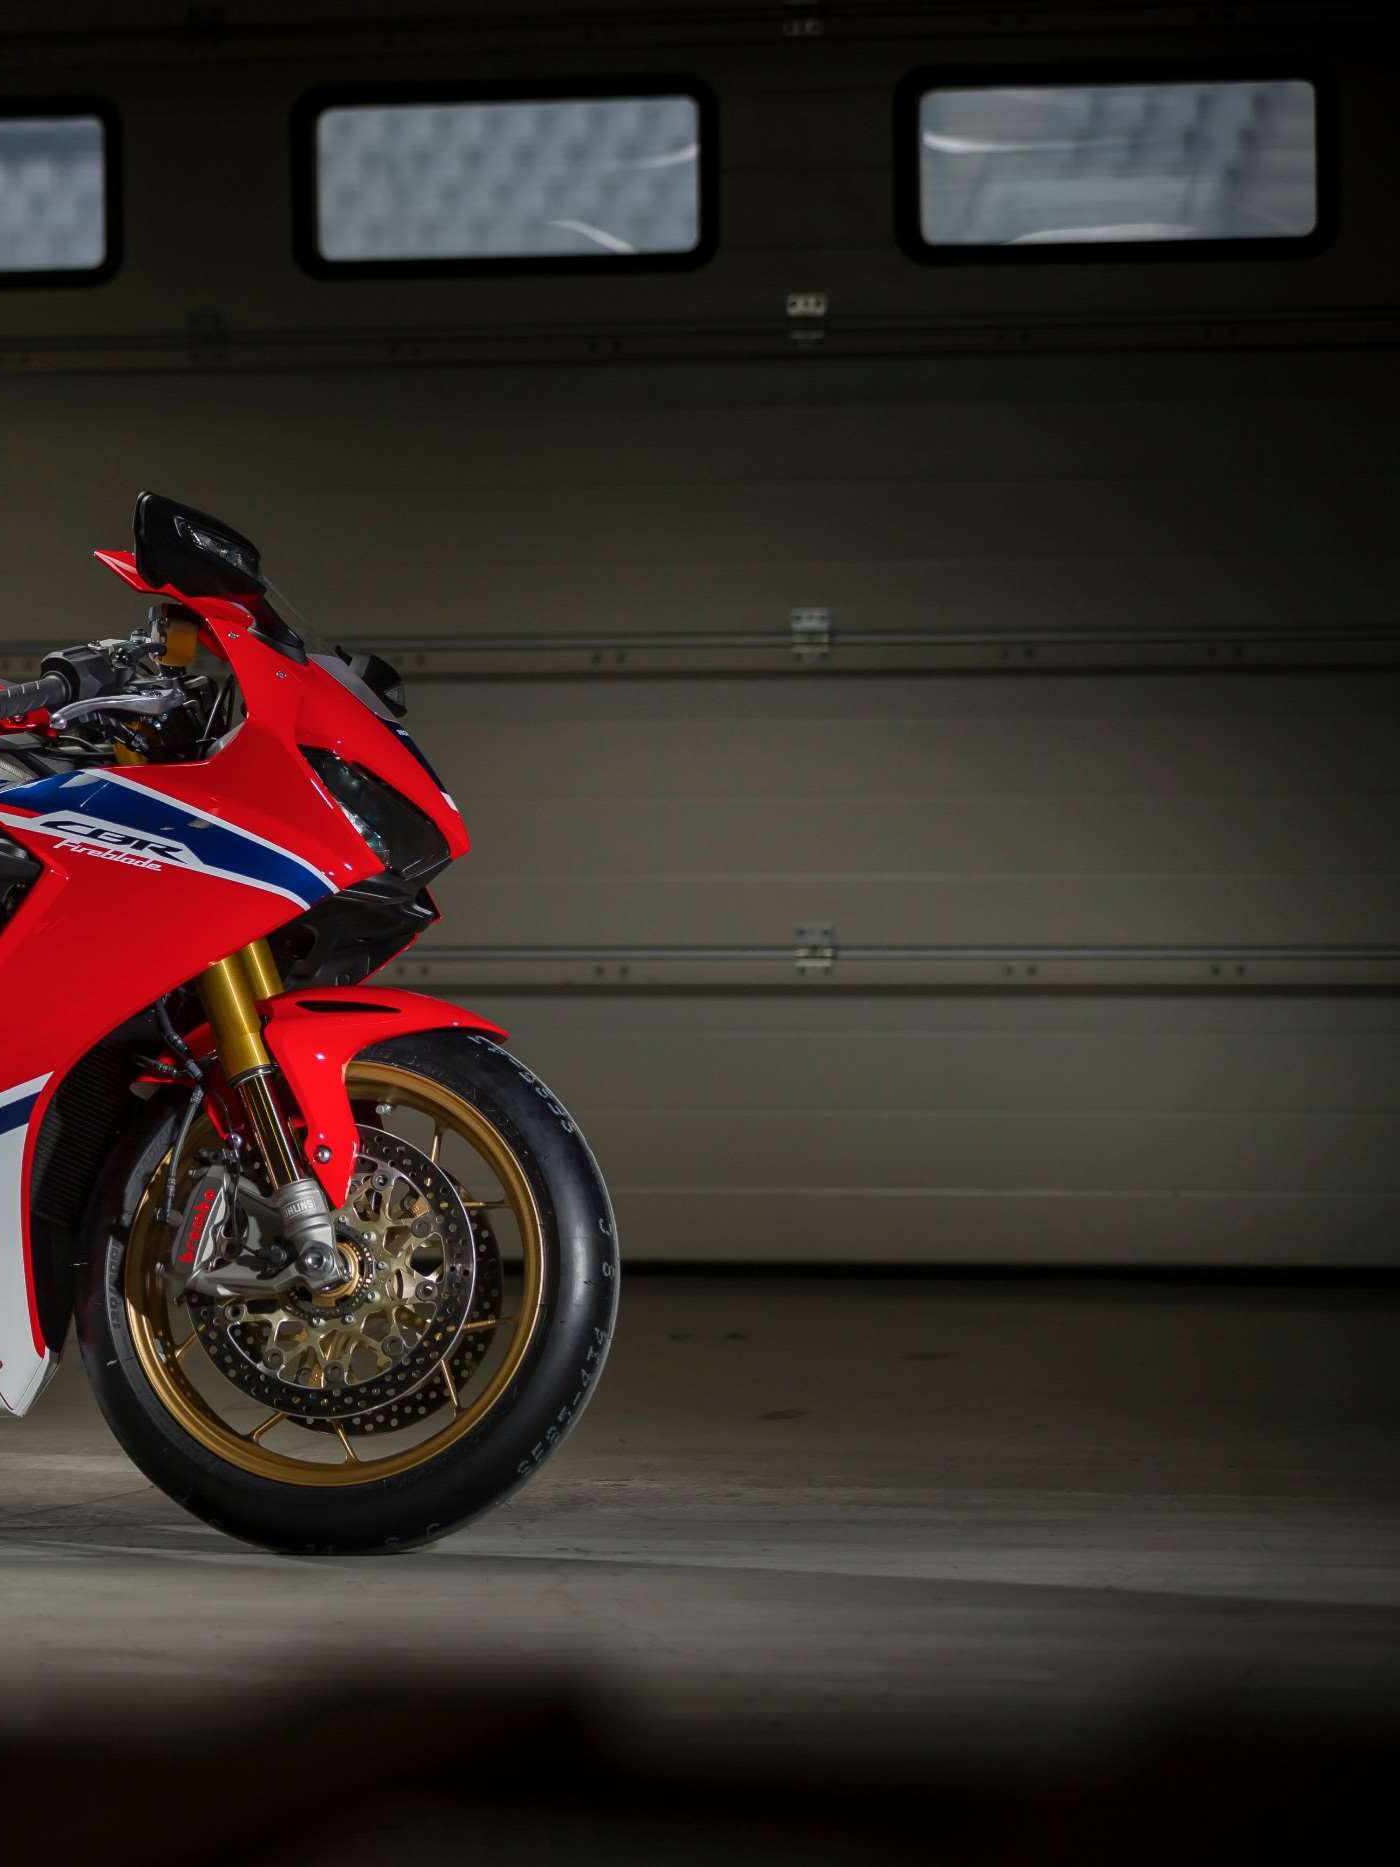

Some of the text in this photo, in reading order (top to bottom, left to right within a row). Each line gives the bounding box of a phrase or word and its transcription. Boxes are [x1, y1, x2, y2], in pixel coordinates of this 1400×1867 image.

[40, 821, 188, 864] CBR
[53, 838, 162, 871] Fireblade
[283, 1199, 315, 1217] HLINS
